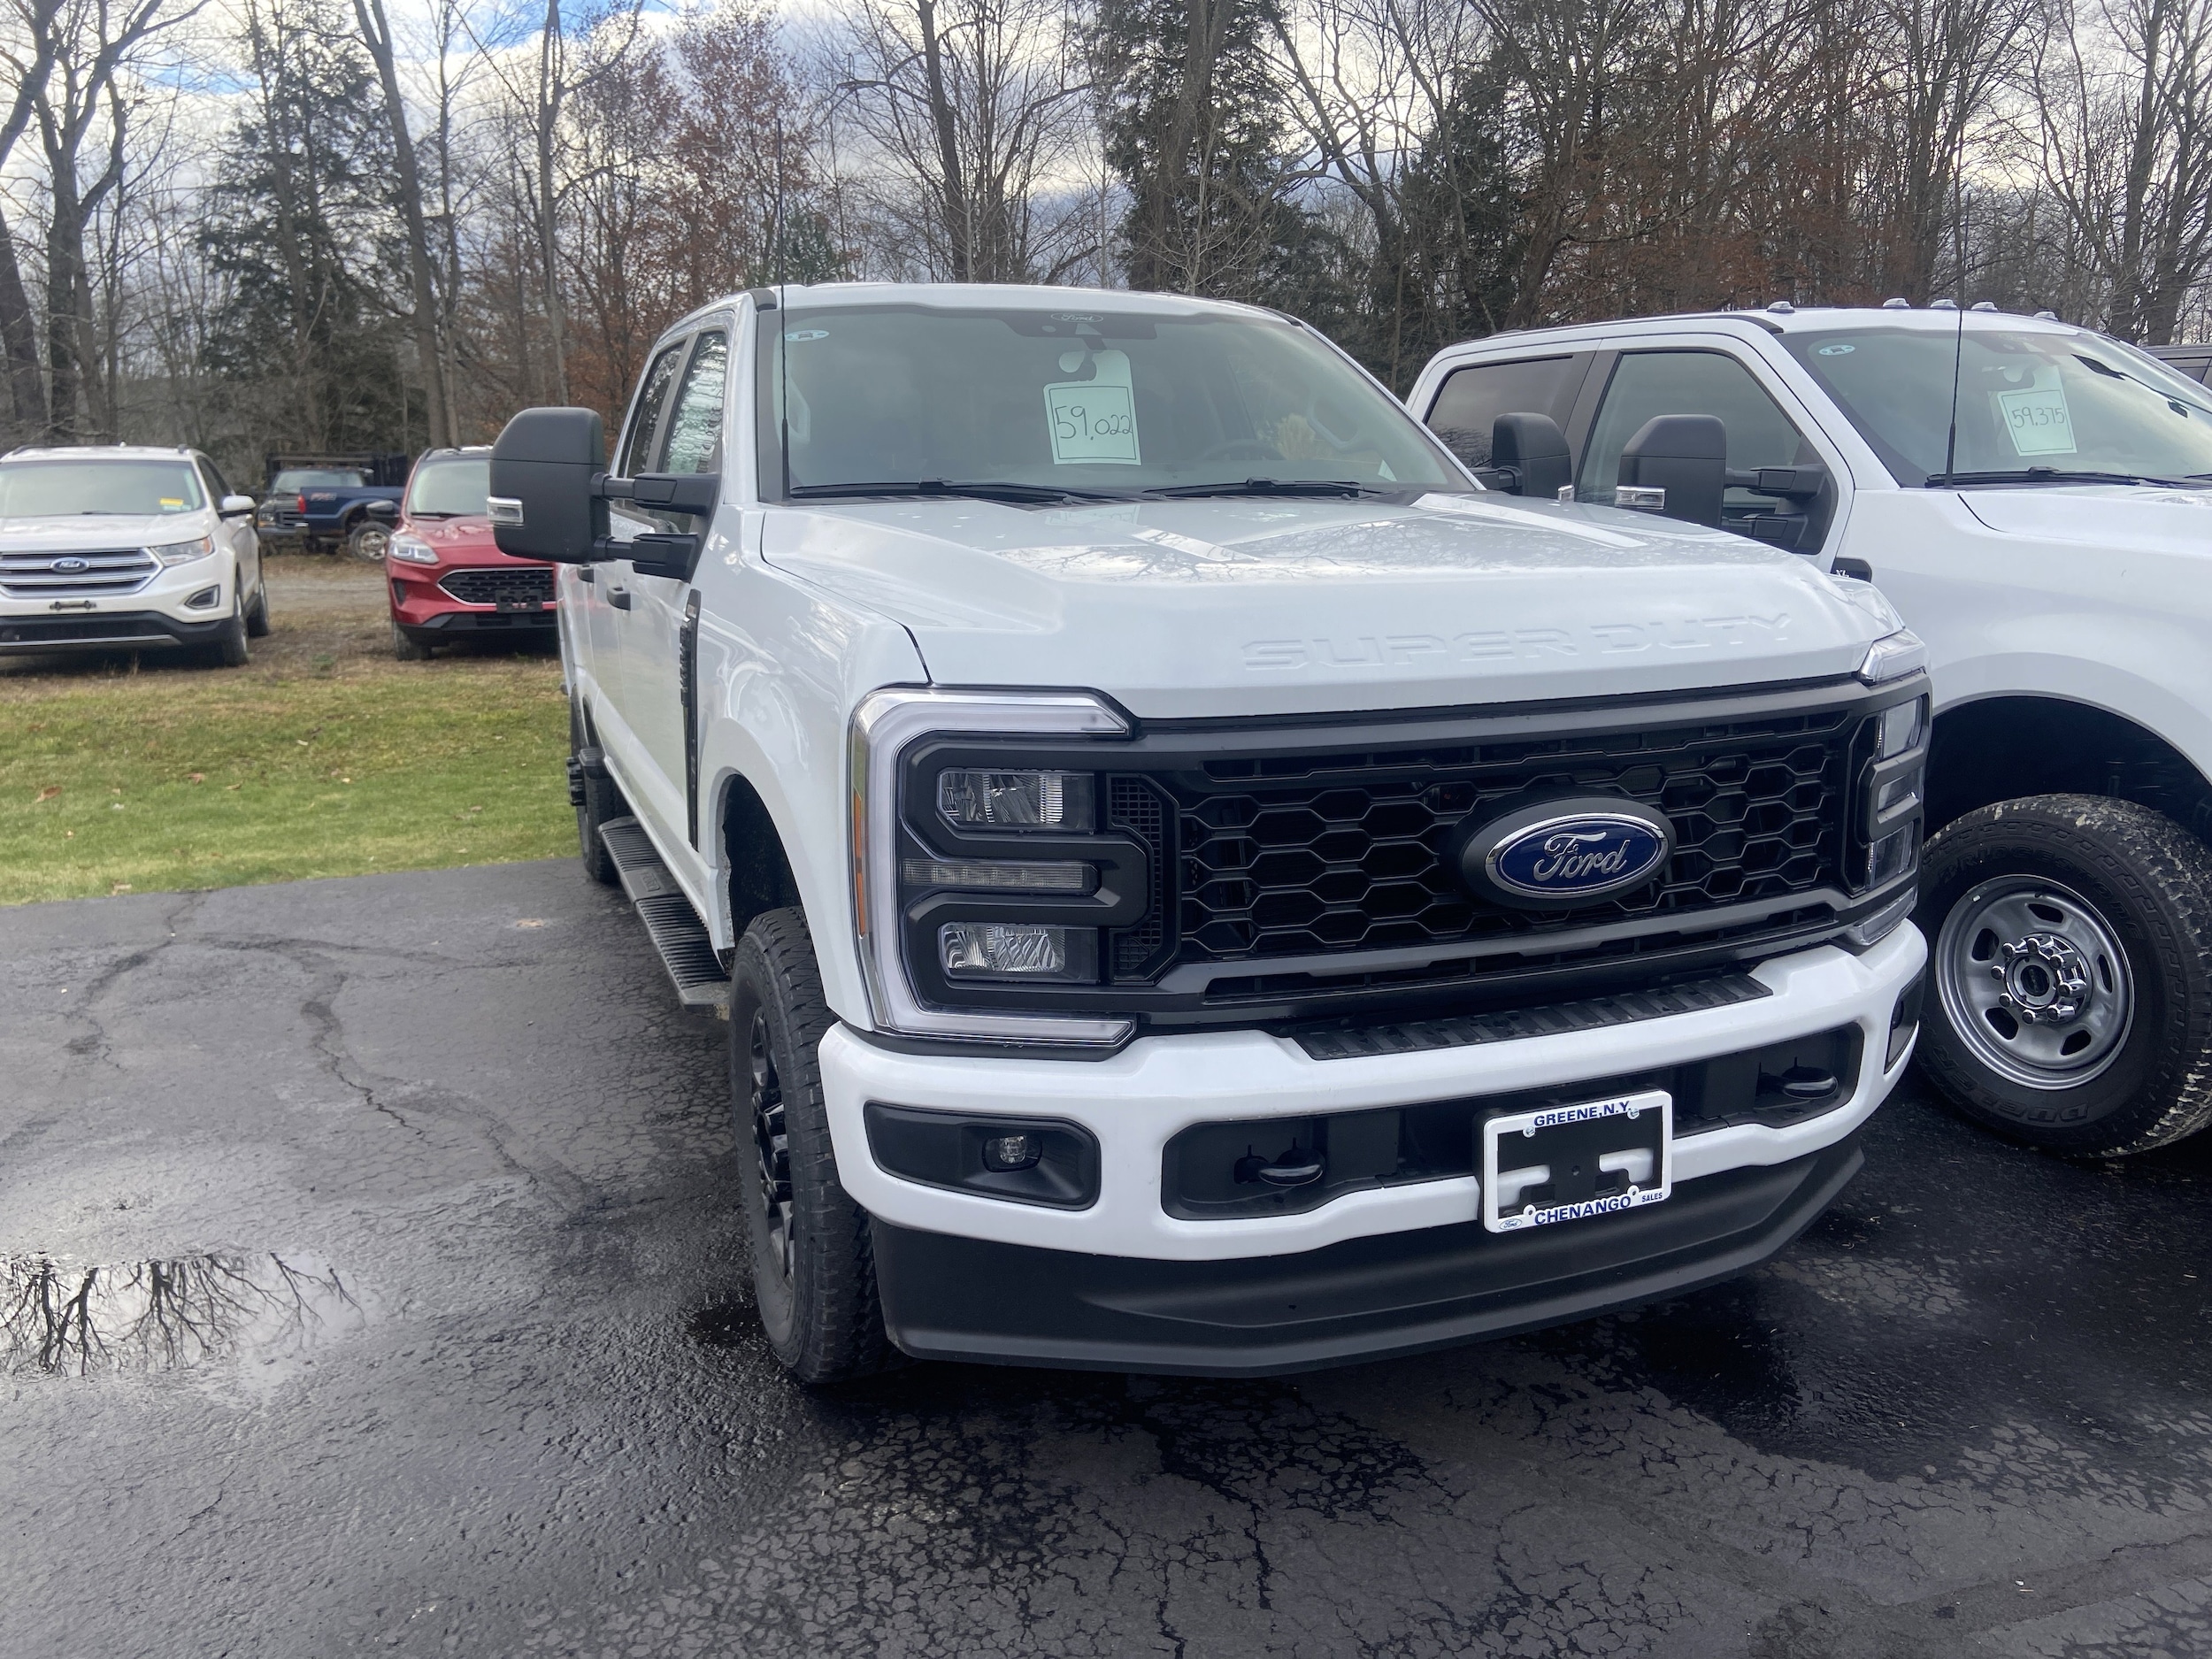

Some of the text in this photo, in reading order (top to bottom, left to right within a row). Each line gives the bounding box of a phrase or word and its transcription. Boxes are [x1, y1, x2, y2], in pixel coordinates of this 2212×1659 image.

[1240, 611, 1792, 671] SUPER DUTY
[1533, 831, 1632, 882] Ford
[1534, 1195, 1632, 1225] CHENANGO
[1641, 1192, 1663, 1203] SALES
